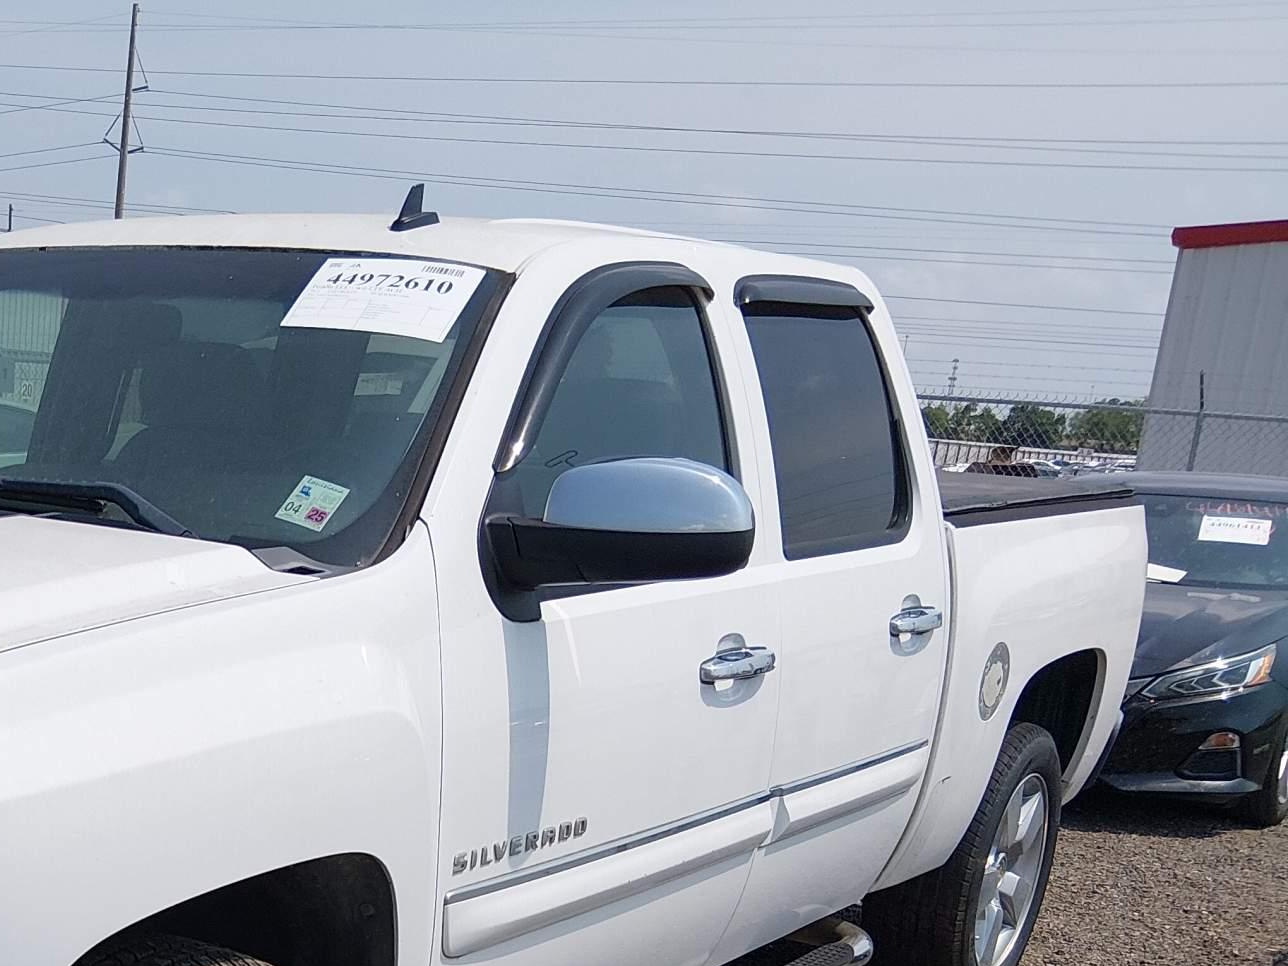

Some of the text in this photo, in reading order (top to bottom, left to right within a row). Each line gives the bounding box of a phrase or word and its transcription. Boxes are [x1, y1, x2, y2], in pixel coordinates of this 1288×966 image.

[326, 271, 454, 295] 44972610
[22, 383, 32, 397] 20
[283, 501, 327, 523] 04 25
[451, 816, 588, 876] SILVERADO
